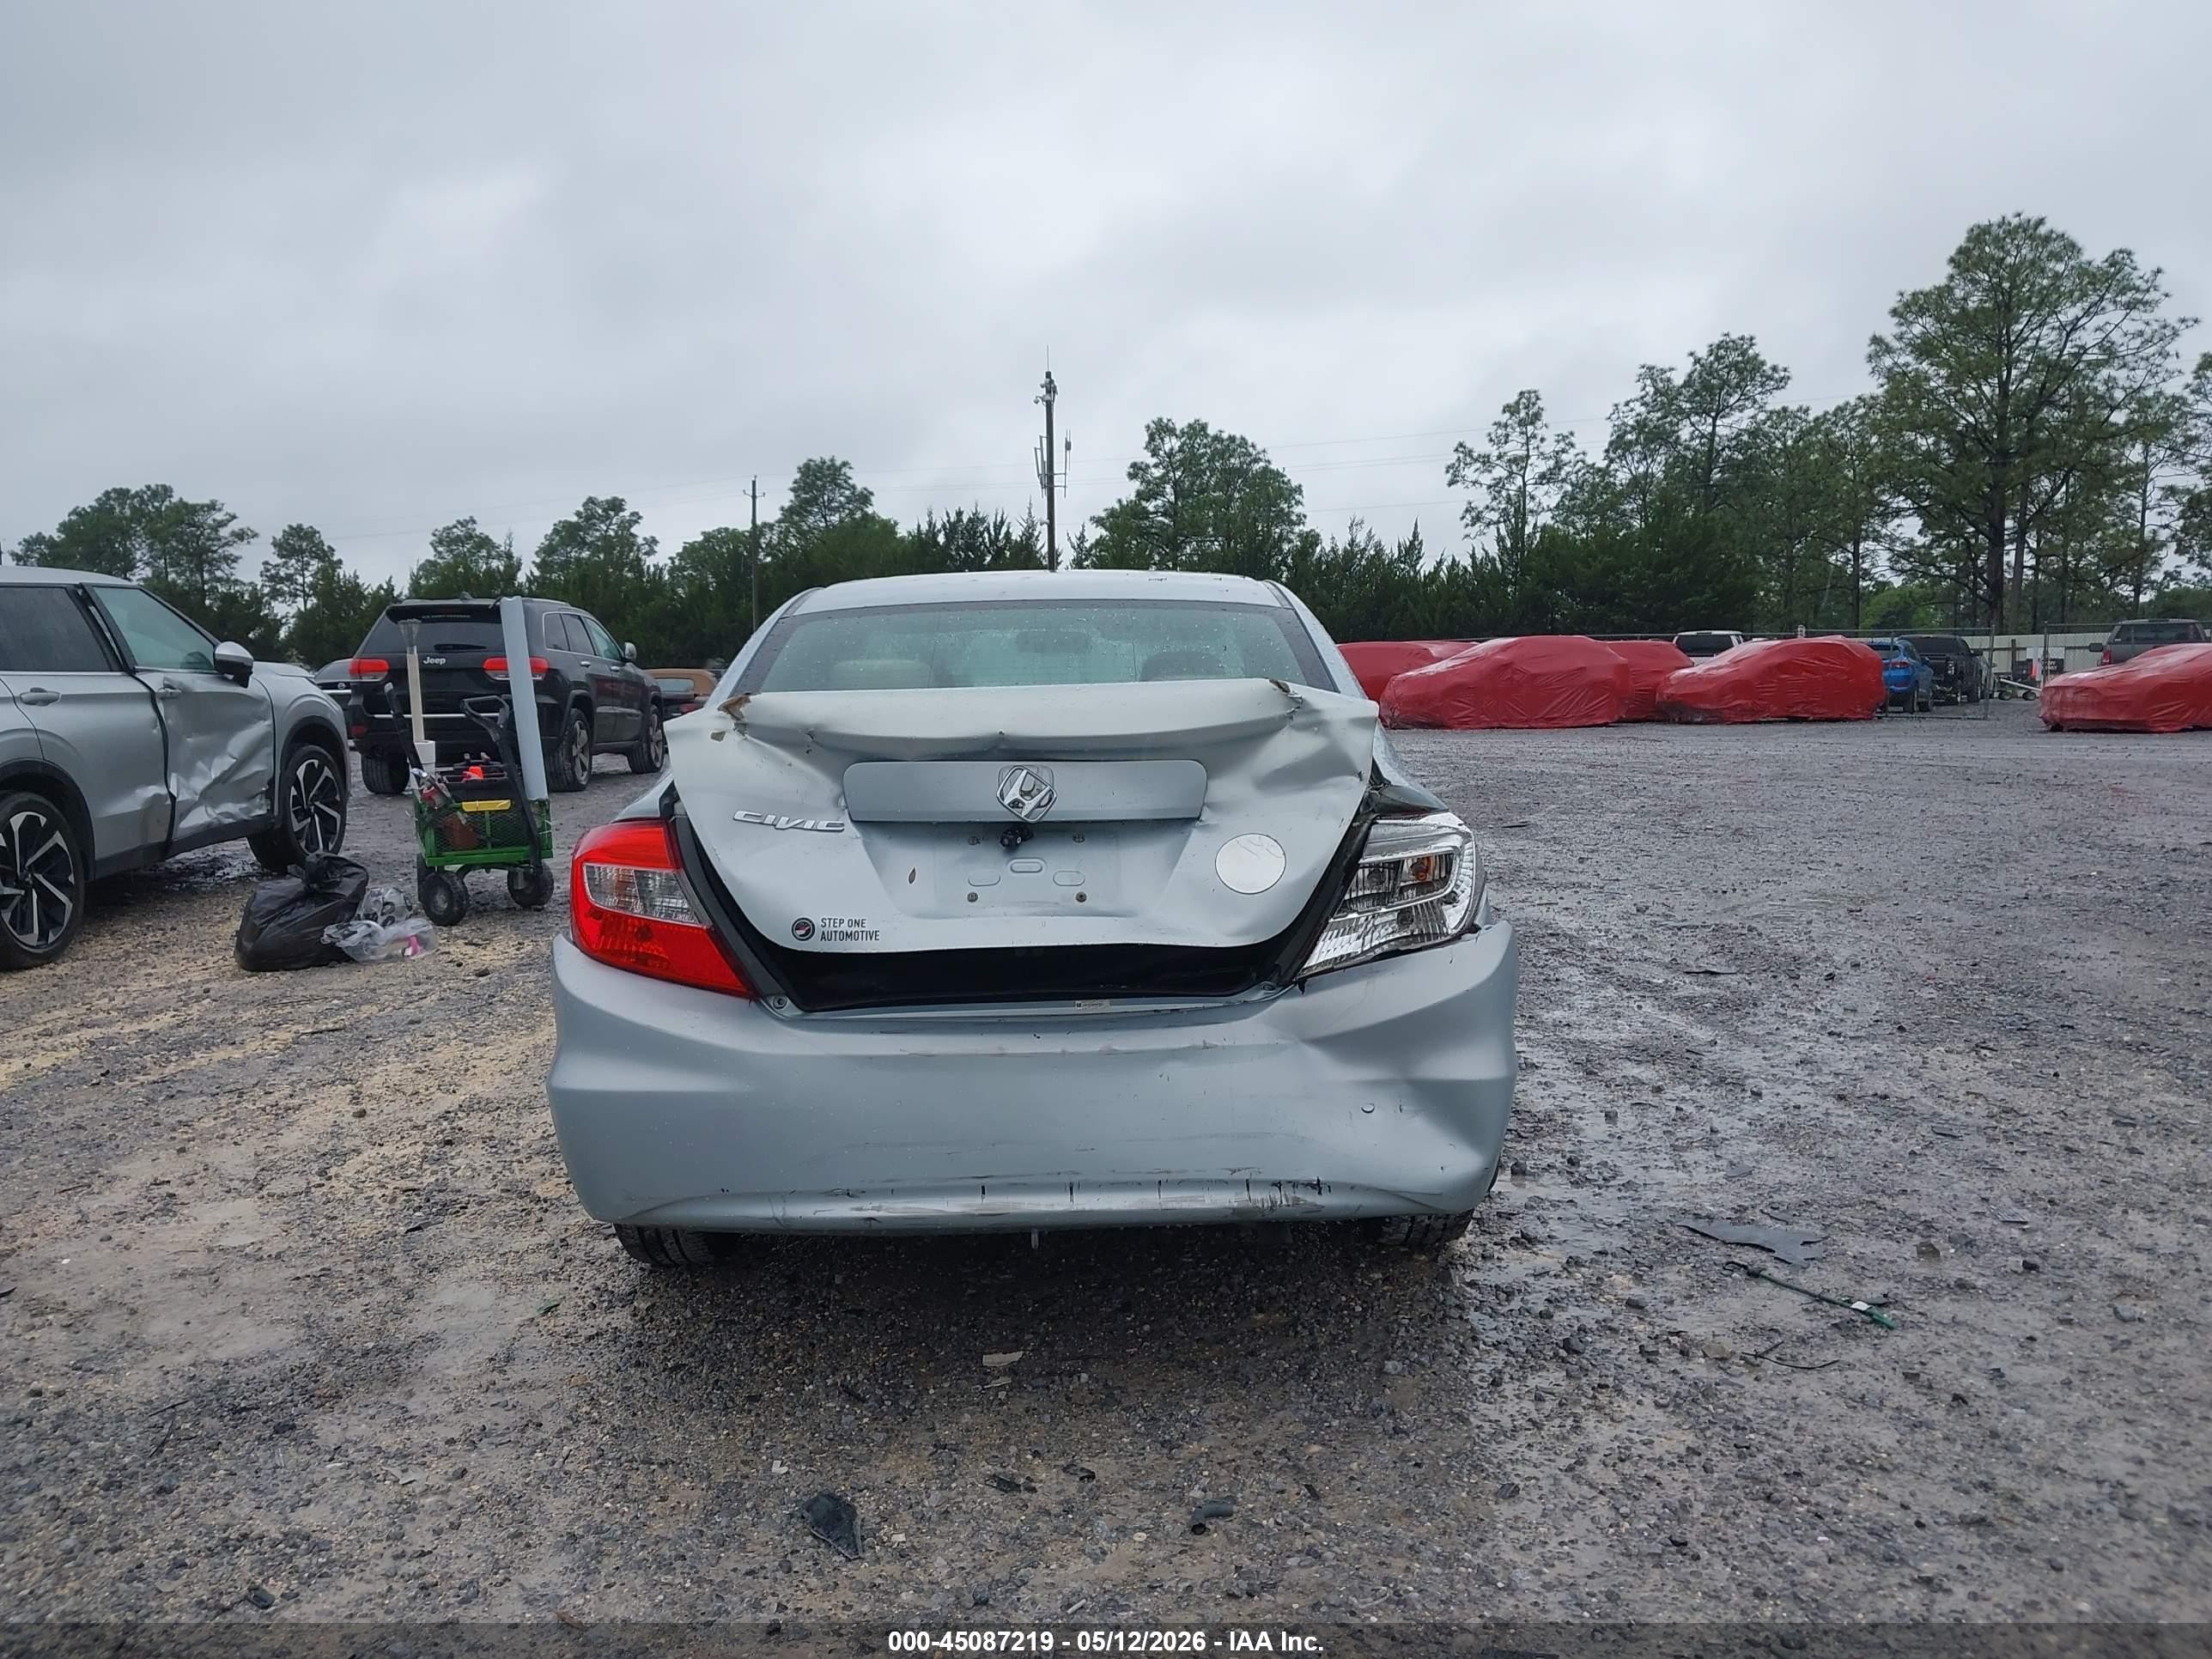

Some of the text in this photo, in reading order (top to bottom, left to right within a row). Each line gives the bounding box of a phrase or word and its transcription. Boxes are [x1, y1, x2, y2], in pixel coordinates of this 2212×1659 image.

[422, 656, 447, 665] Jeep
[732, 810, 845, 833] CIVIC
[821, 918, 866, 928] STEP ONE
[820, 930, 880, 942] AUTOMOTIVE
